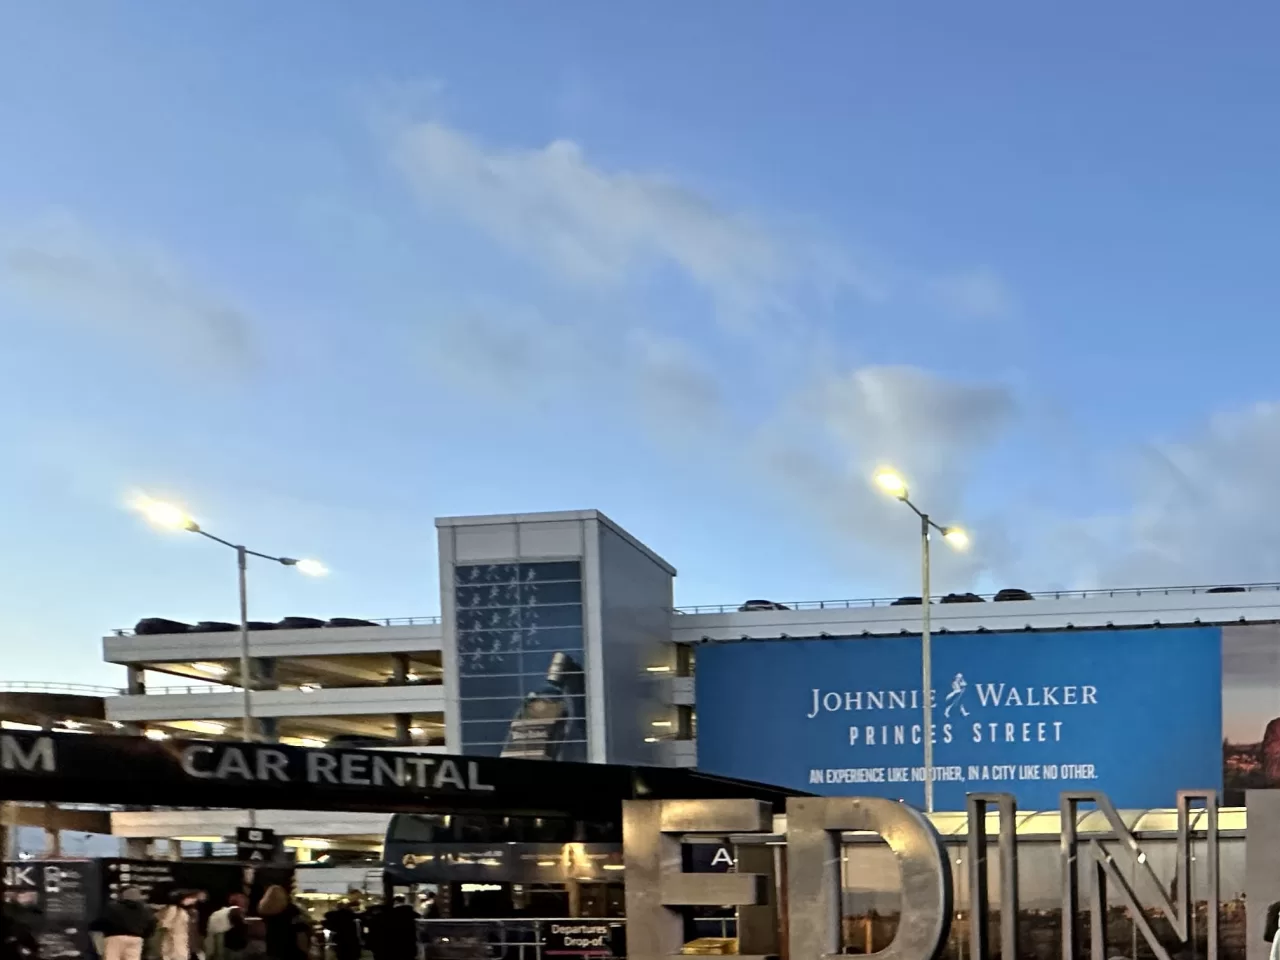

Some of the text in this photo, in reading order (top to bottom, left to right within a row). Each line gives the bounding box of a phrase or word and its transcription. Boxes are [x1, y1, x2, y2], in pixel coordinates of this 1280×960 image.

[975, 683, 1098, 707] WALKER
[849, 721, 1063, 746] PRINCES STREET
[181, 744, 495, 791] CAR RENTAL
[809, 769, 824, 784] AN
[826, 767, 885, 784] EXPERIENCE
[888, 766, 909, 783] LIKE
[911, 766, 926, 782] NO
[968, 764, 980, 781] IN
[982, 764, 990, 780] A
[992, 764, 1016, 781] CITY
[1019, 764, 1041, 780] LIKE
[1043, 764, 1058, 780] NO
[1060, 763, 1099, 780] OTHER.
[711, 847, 734, 866] A
[551, 924, 608, 936] Departures
[563, 936, 604, 948] Drop-of
